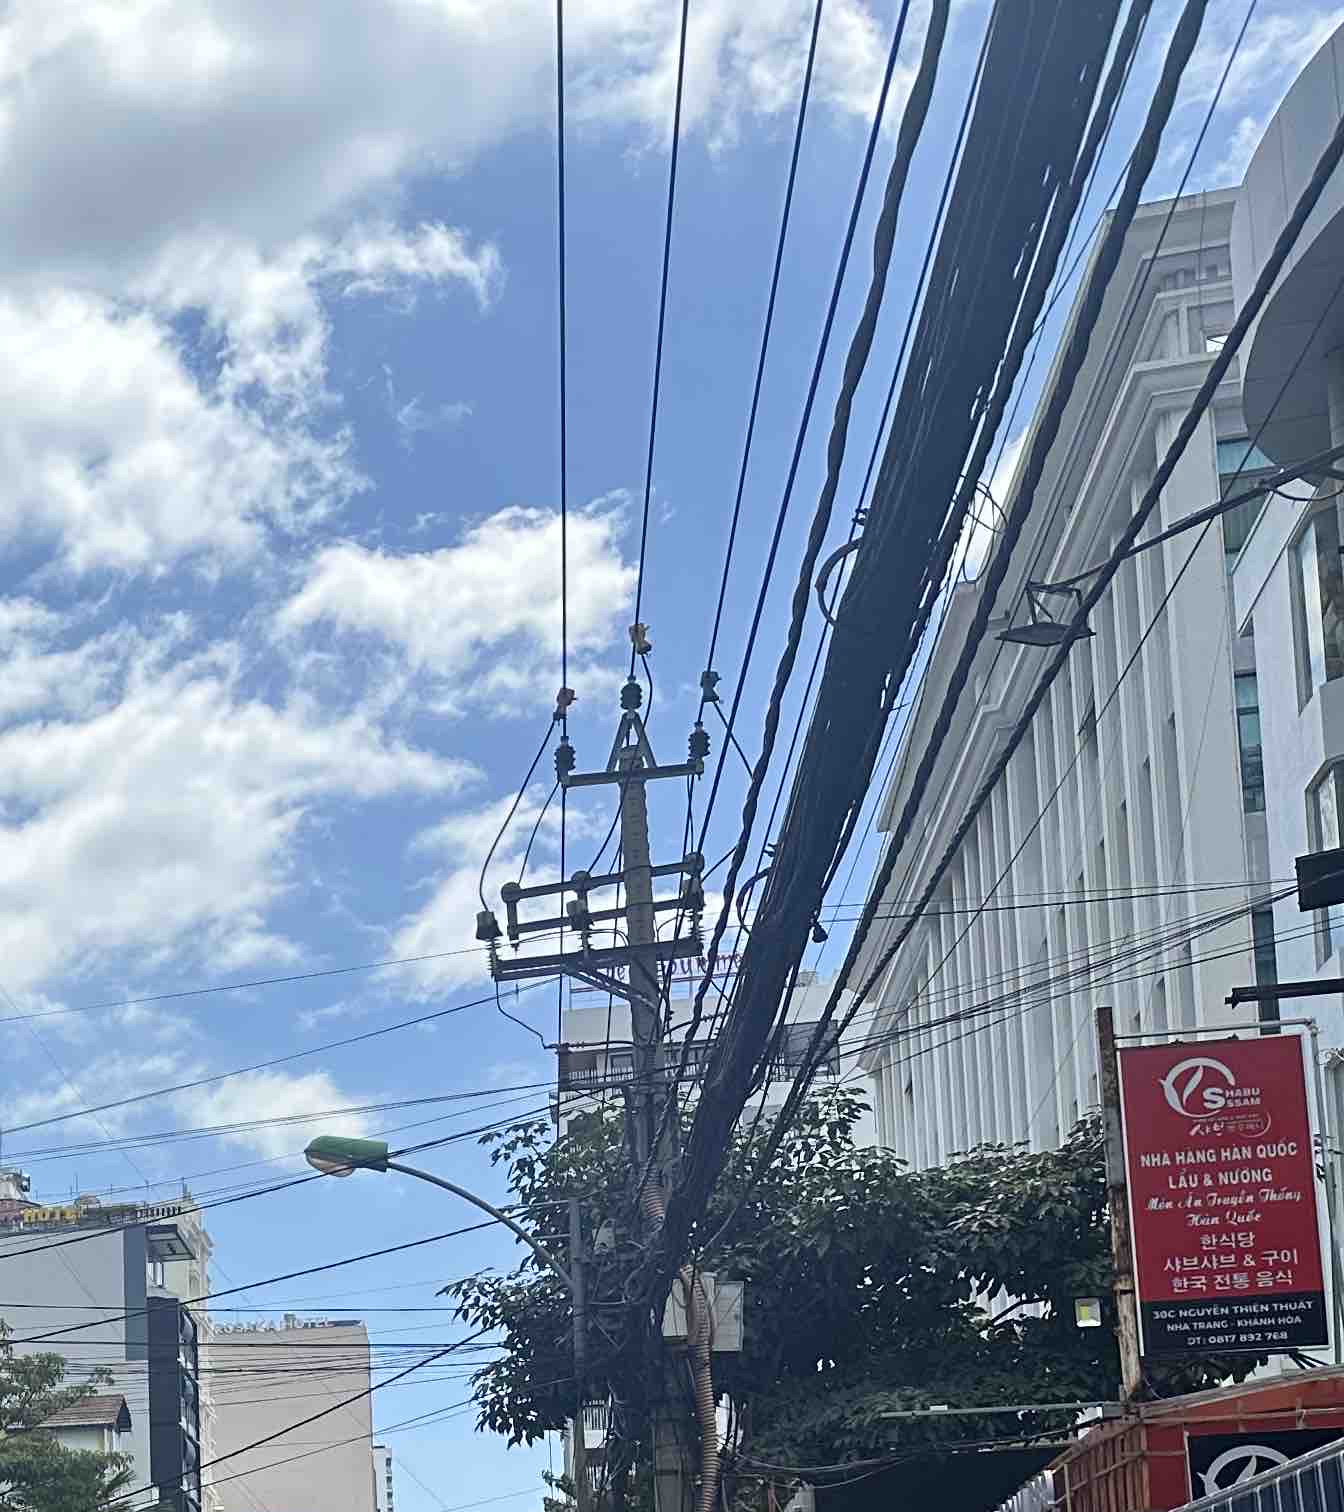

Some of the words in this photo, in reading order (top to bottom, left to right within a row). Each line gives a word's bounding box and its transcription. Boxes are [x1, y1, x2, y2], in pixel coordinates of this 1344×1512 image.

[1199, 1231, 1256, 1250] 한식당
[1164, 1253, 1238, 1273] 샤브샤브
[1261, 1248, 1298, 1267] 구이
[1171, 1275, 1207, 1293] 한국
[1214, 1272, 1250, 1291] 전통
[1255, 1269, 1294, 1288] 음식
